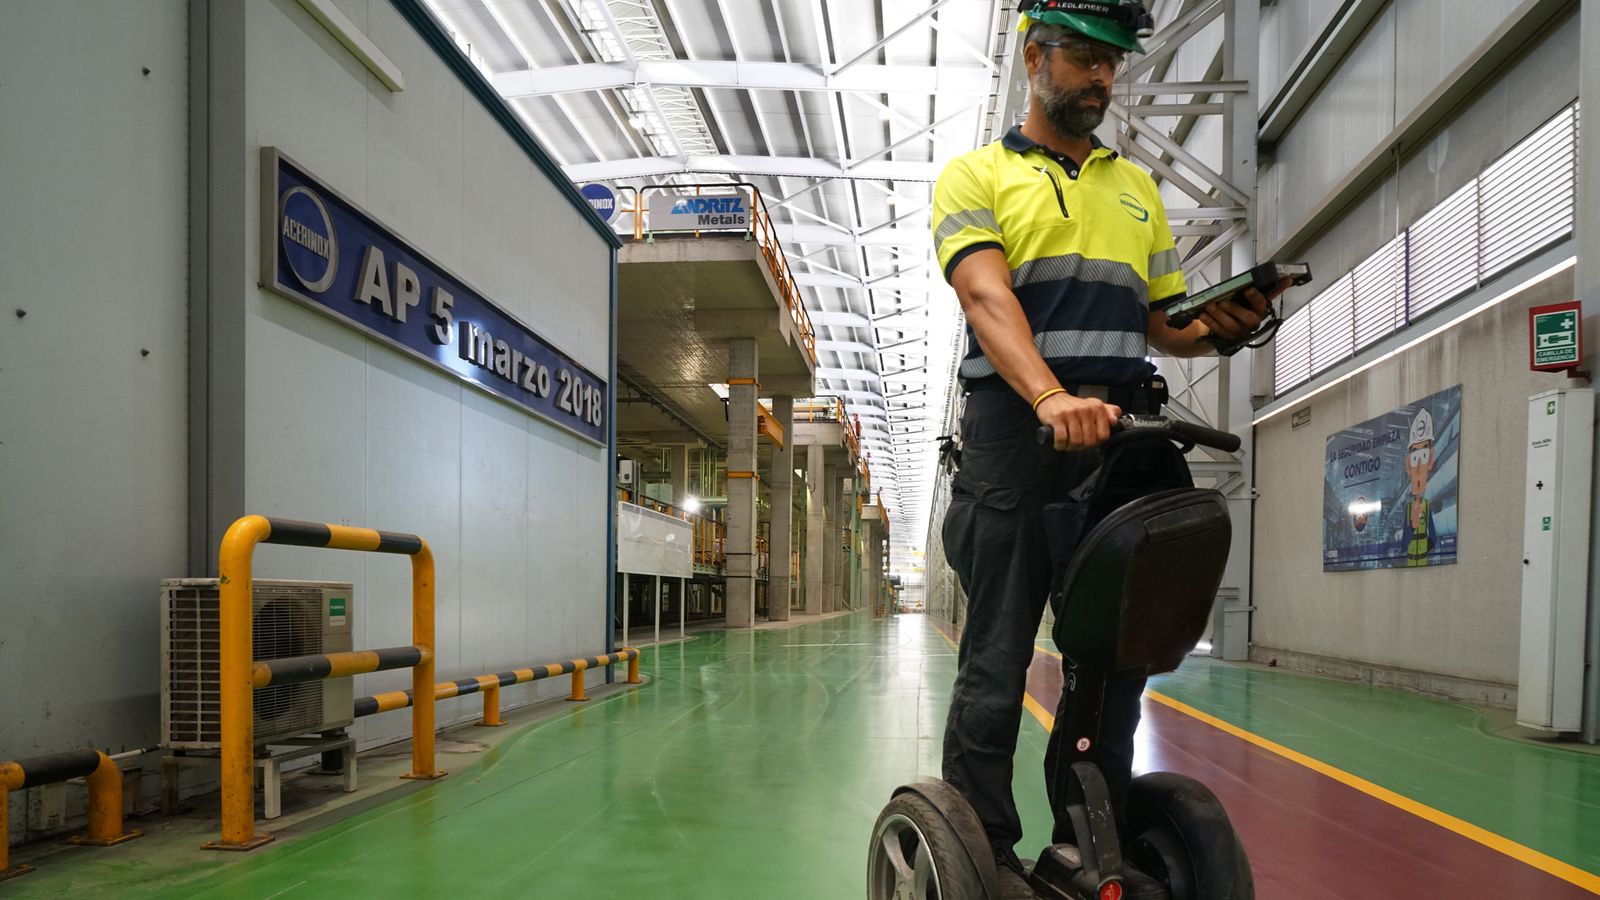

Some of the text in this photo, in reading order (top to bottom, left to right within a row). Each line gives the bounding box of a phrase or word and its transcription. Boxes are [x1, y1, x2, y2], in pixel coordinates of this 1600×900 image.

[588, 198, 613, 210] INOX
[671, 197, 745, 215] ANDRITZ
[698, 214, 745, 225] Metals
[283, 214, 330, 260] ACERINOX
[355, 245, 602, 428] AP 5 marzo 2018
[1330, 429, 1401, 462] LA SEGURIDAD EMPIEZA
[1344, 456, 1381, 479] CONTIGO
